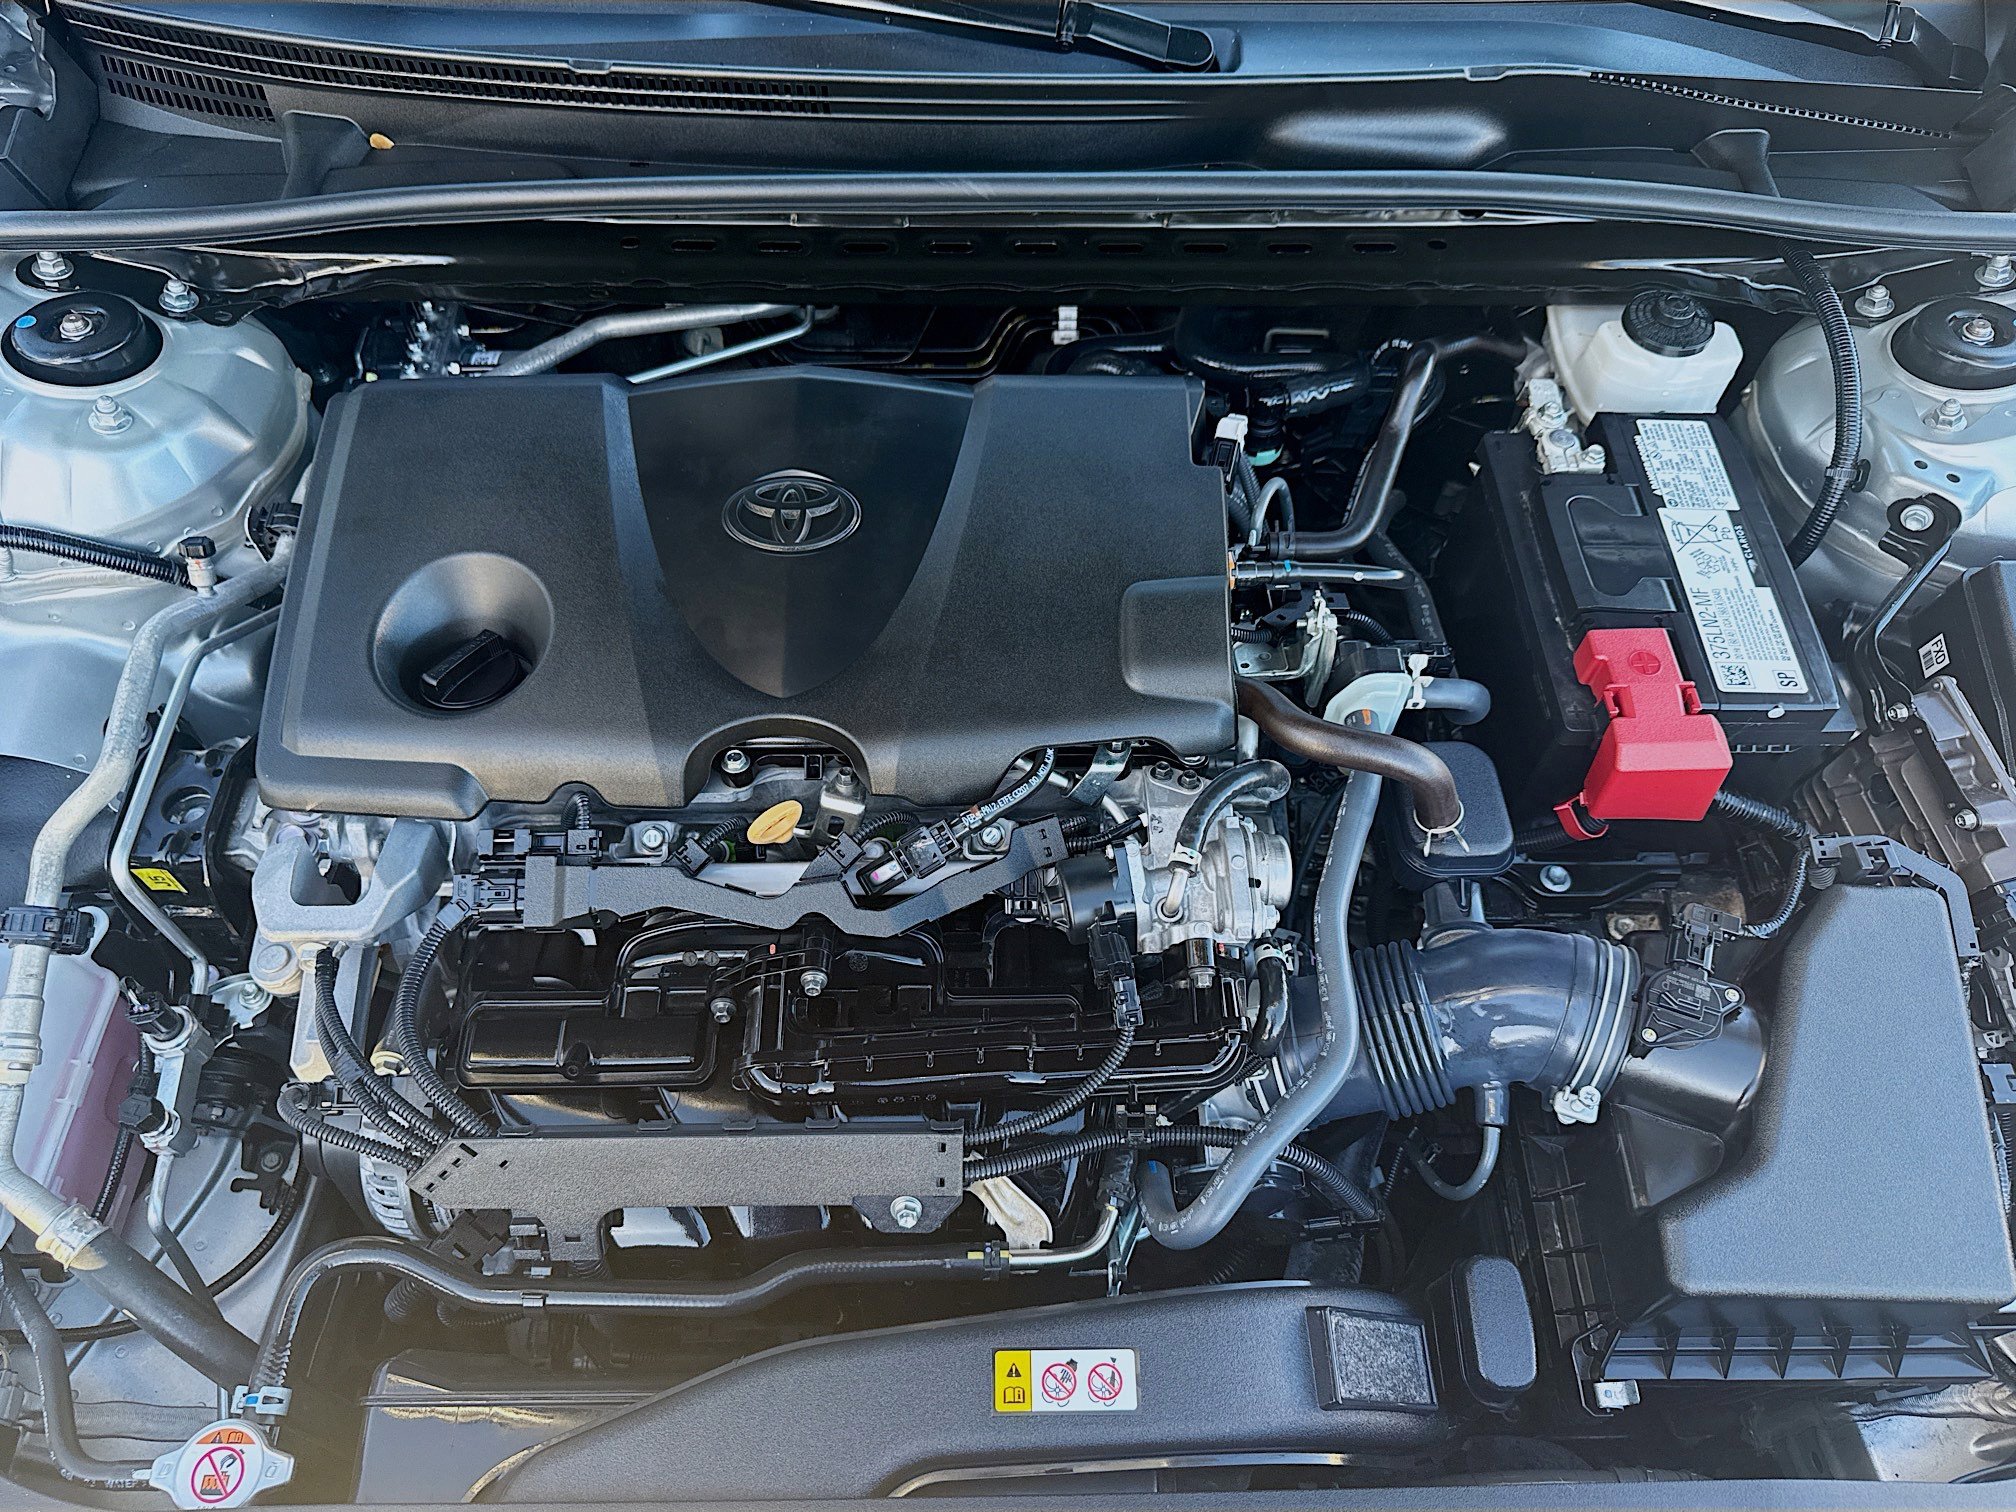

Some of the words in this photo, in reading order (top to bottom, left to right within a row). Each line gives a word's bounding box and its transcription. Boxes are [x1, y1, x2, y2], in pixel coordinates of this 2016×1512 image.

[1721, 527, 1734, 541] Pb
[1734, 525, 1754, 559] CLARIOS
[1690, 587, 1731, 660] 375LN2-MF
[1932, 638, 1946, 664] FXD
[1777, 672, 1798, 687] SP
[1028, 774, 1040, 786] DO
[1036, 763, 1048, 777] NOT
[148, 875, 171, 886] J5
